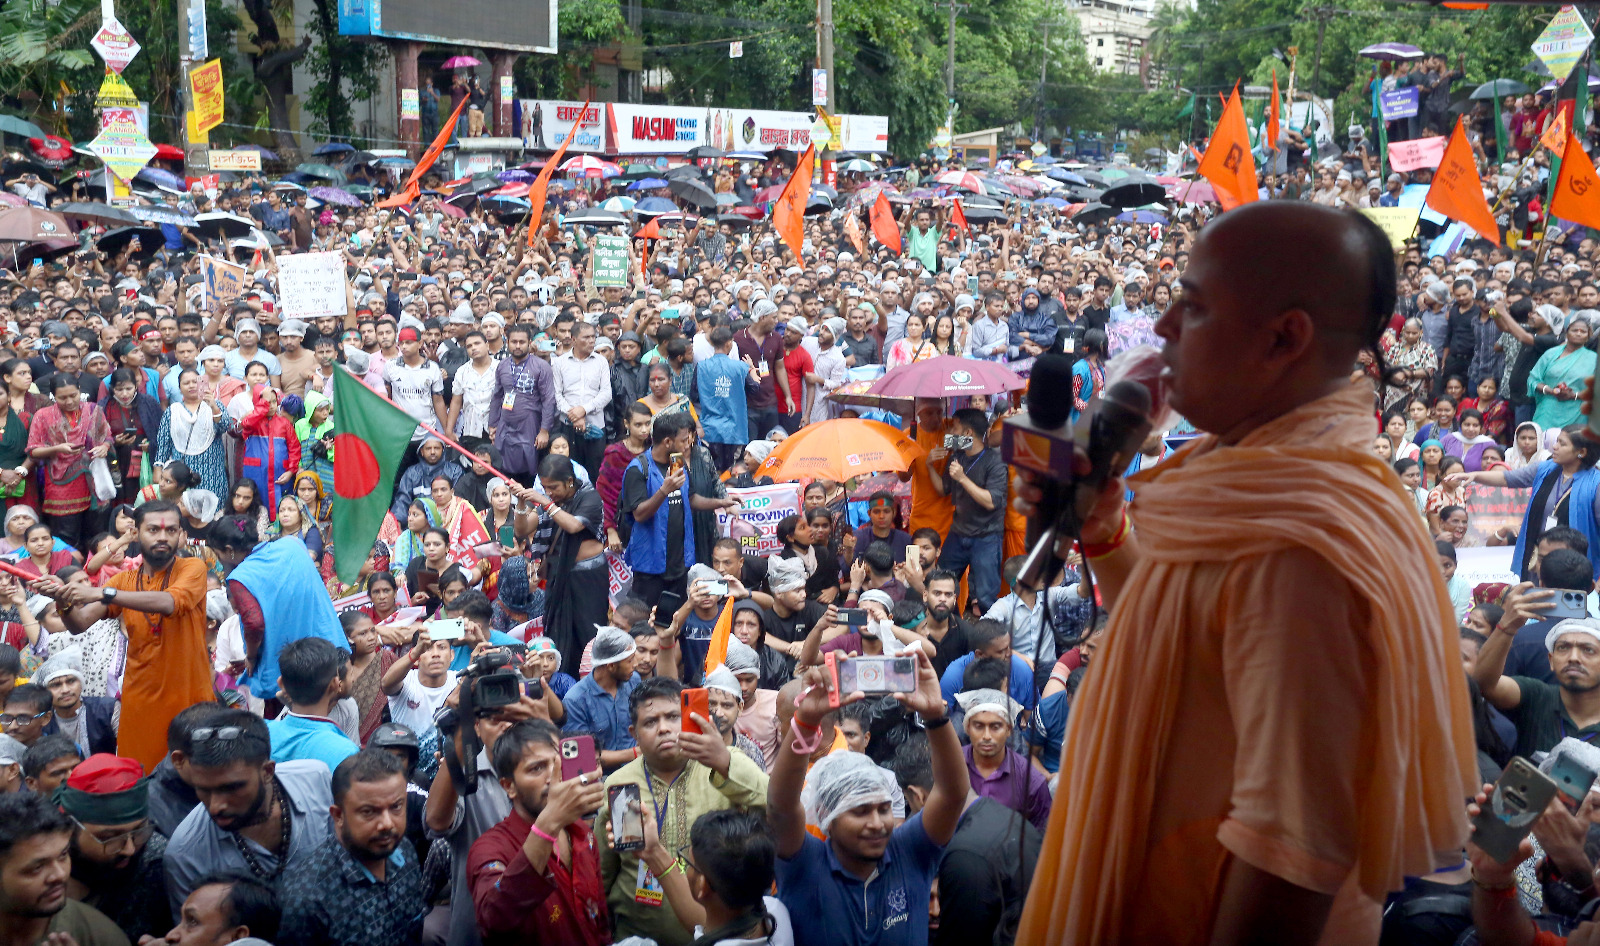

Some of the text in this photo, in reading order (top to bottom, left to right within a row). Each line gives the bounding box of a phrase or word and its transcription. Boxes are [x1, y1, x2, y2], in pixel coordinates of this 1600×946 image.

[1542, 40, 1572, 53] DELTA
[632, 115, 698, 141] MASUM CLOTH
[675, 131, 697, 142] STORE
[102, 146, 135, 156] DELTA
[1467, 504, 1485, 513] AVE
[718, 508, 795, 525] DTROYING
